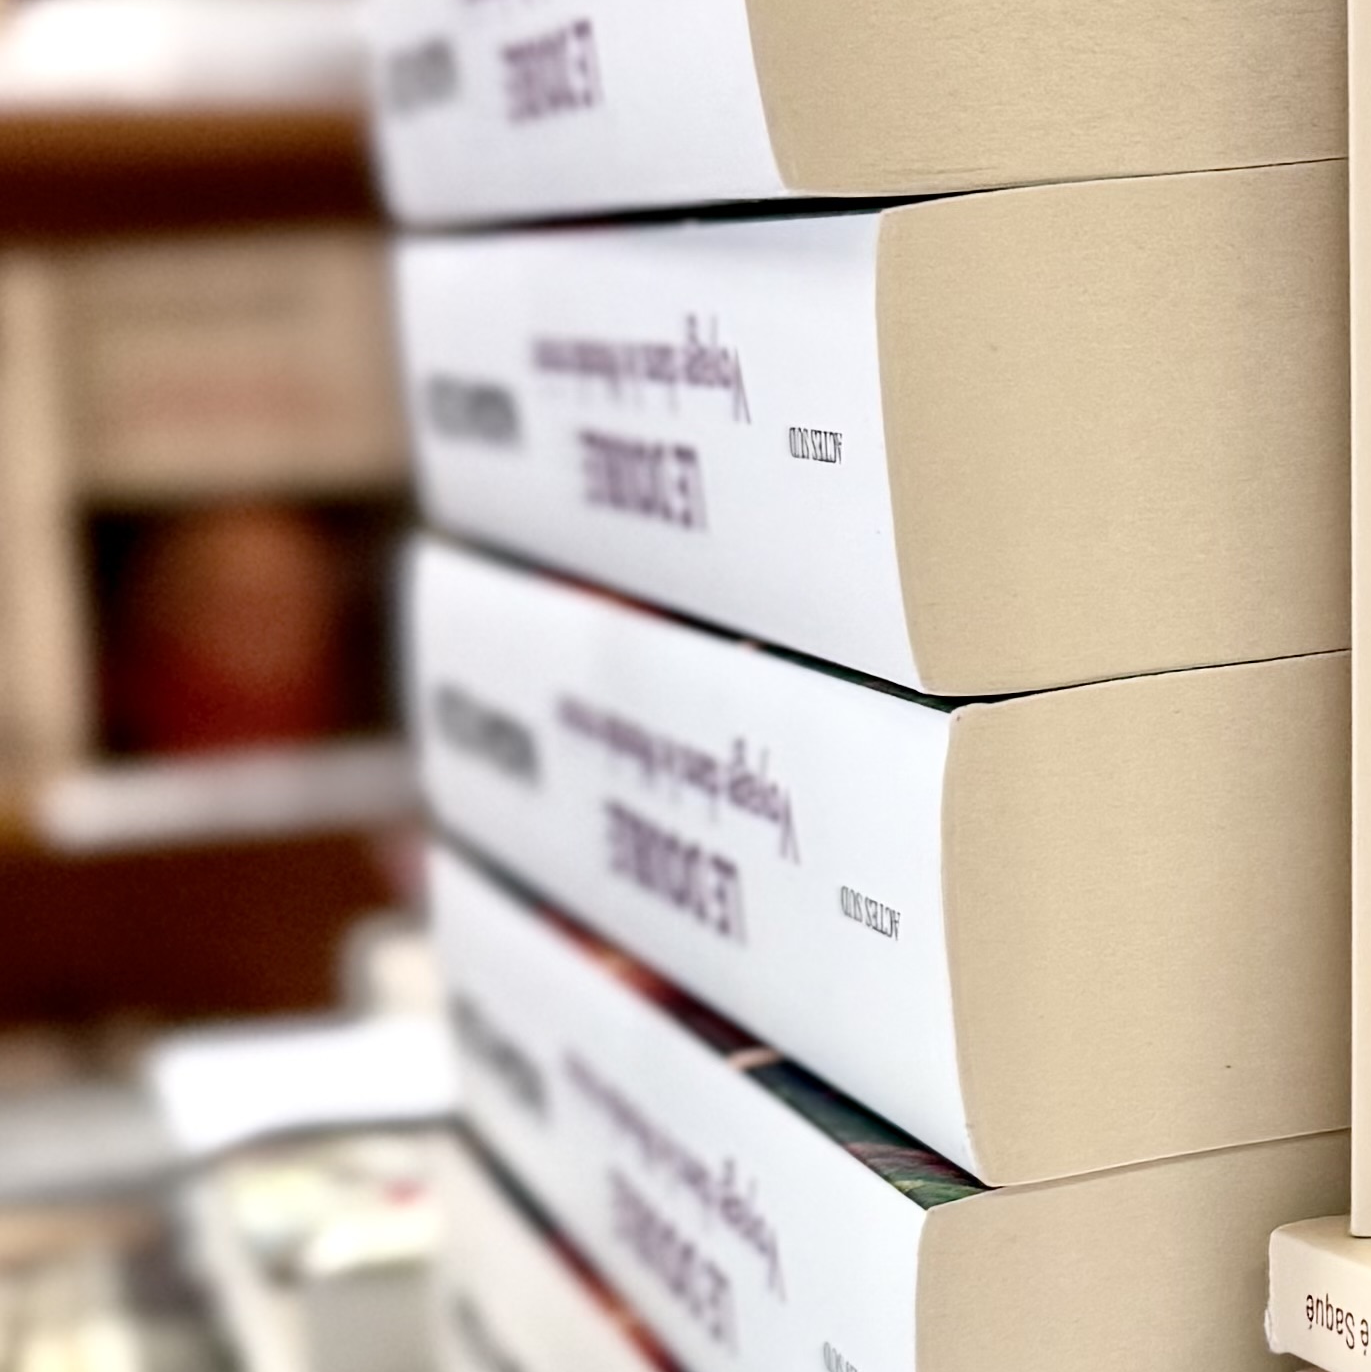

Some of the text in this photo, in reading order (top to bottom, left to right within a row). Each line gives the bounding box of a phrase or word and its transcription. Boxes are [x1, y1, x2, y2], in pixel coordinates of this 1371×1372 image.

[789, 427, 842, 465] ACTES SUD
[840, 885, 900, 941] ACTES SUD
[1305, 1293, 1355, 1350] Saqué
